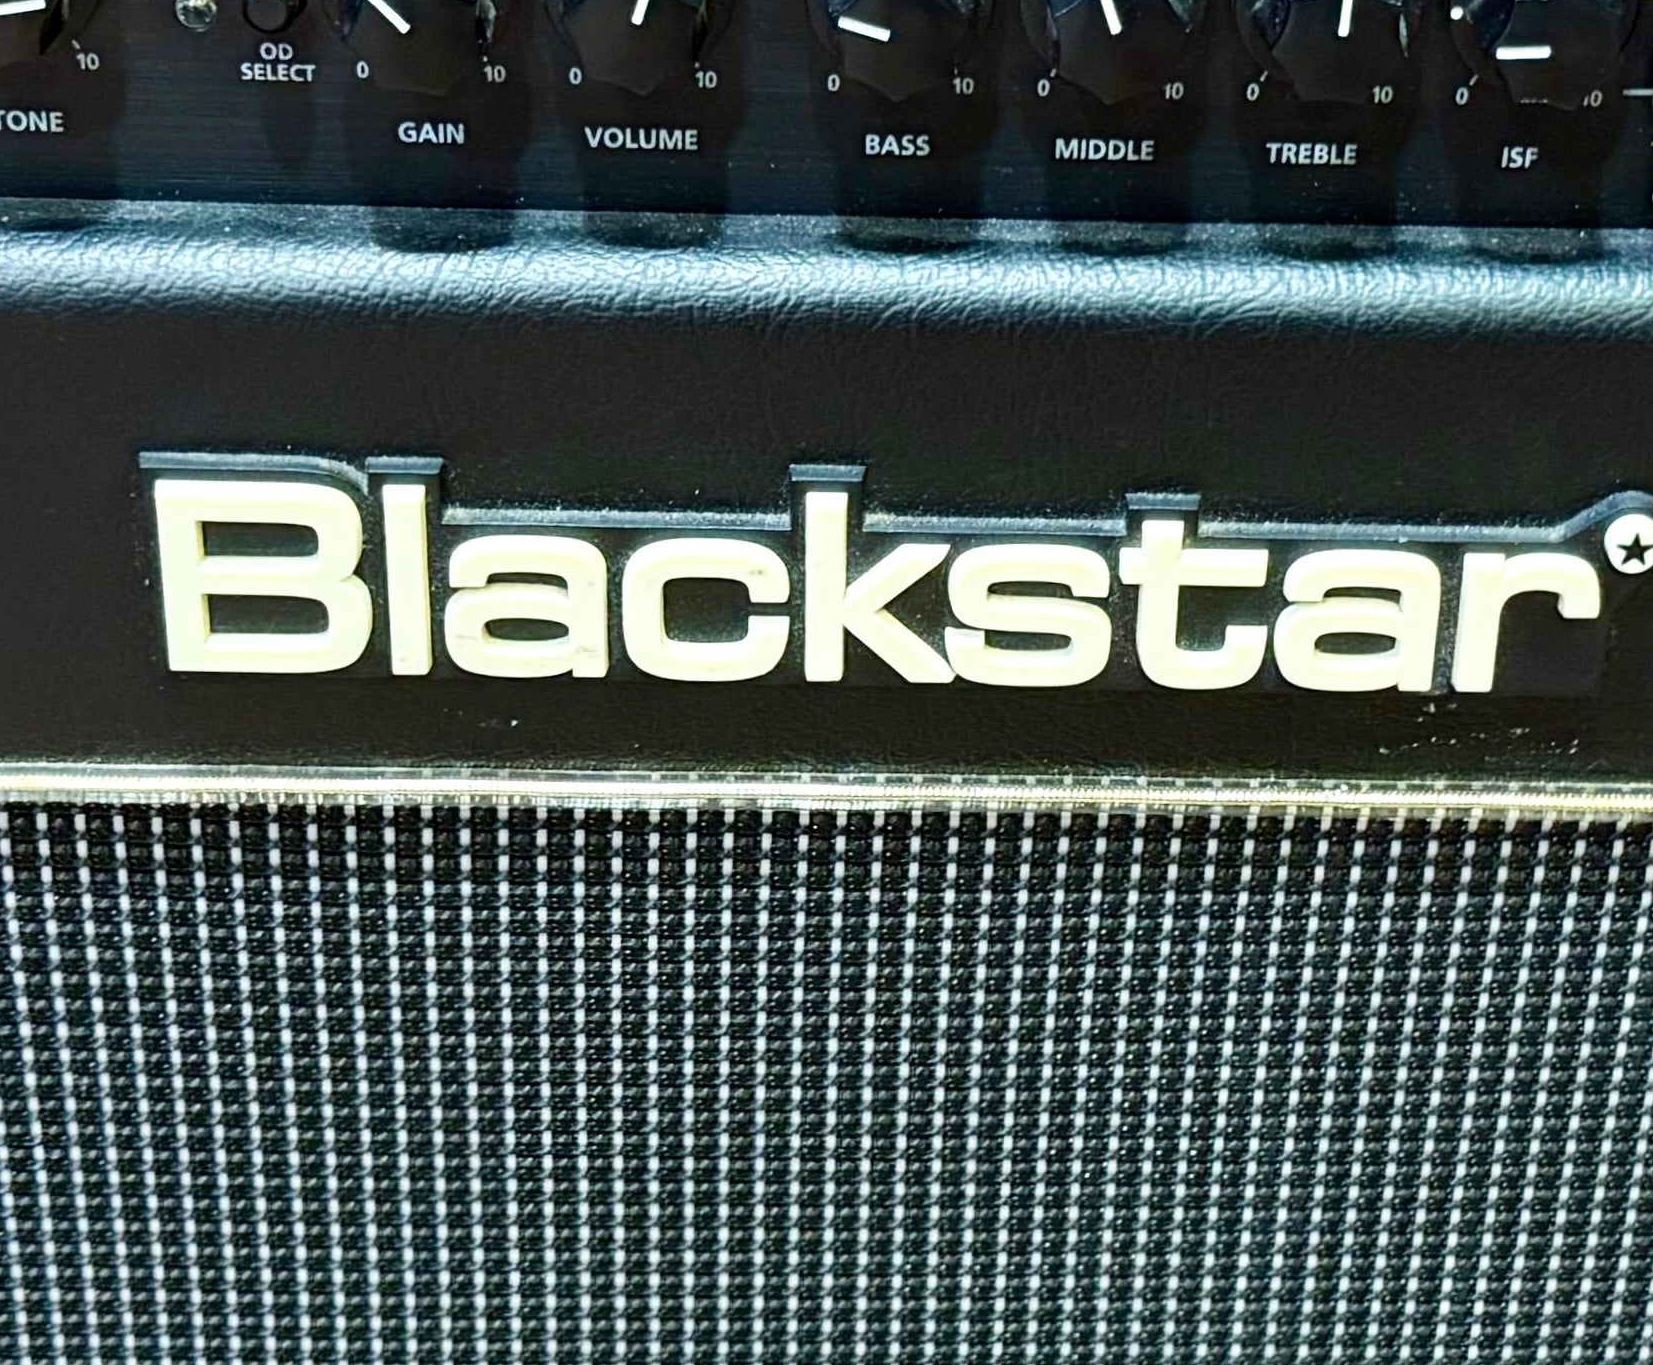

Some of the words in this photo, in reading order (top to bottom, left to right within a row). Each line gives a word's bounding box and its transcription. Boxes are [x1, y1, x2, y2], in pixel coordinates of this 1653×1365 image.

[76, 52, 100, 70] 10
[259, 42, 293, 61] OD
[240, 62, 316, 82] SELECT
[356, 60, 370, 79] 0
[483, 65, 506, 83] 10
[568, 67, 582, 85] 0
[695, 70, 718, 89] 10
[827, 74, 841, 92] 0
[952, 77, 975, 94] 10
[1037, 78, 1051, 97] 0
[1165, 82, 1184, 100] 10
[1246, 83, 1260, 101] 0
[1372, 85, 1393, 104] 10
[1455, 87, 1469, 105] 0
[398, 121, 465, 144] GAIN
[584, 126, 698, 150] VOLUME
[865, 134, 930, 156] BASS
[1055, 138, 1154, 161] MIDDLE
[1265, 142, 1357, 165] TREBLE
[1500, 145, 1541, 169] ISF
[154, 478, 1602, 694] Blackstar
